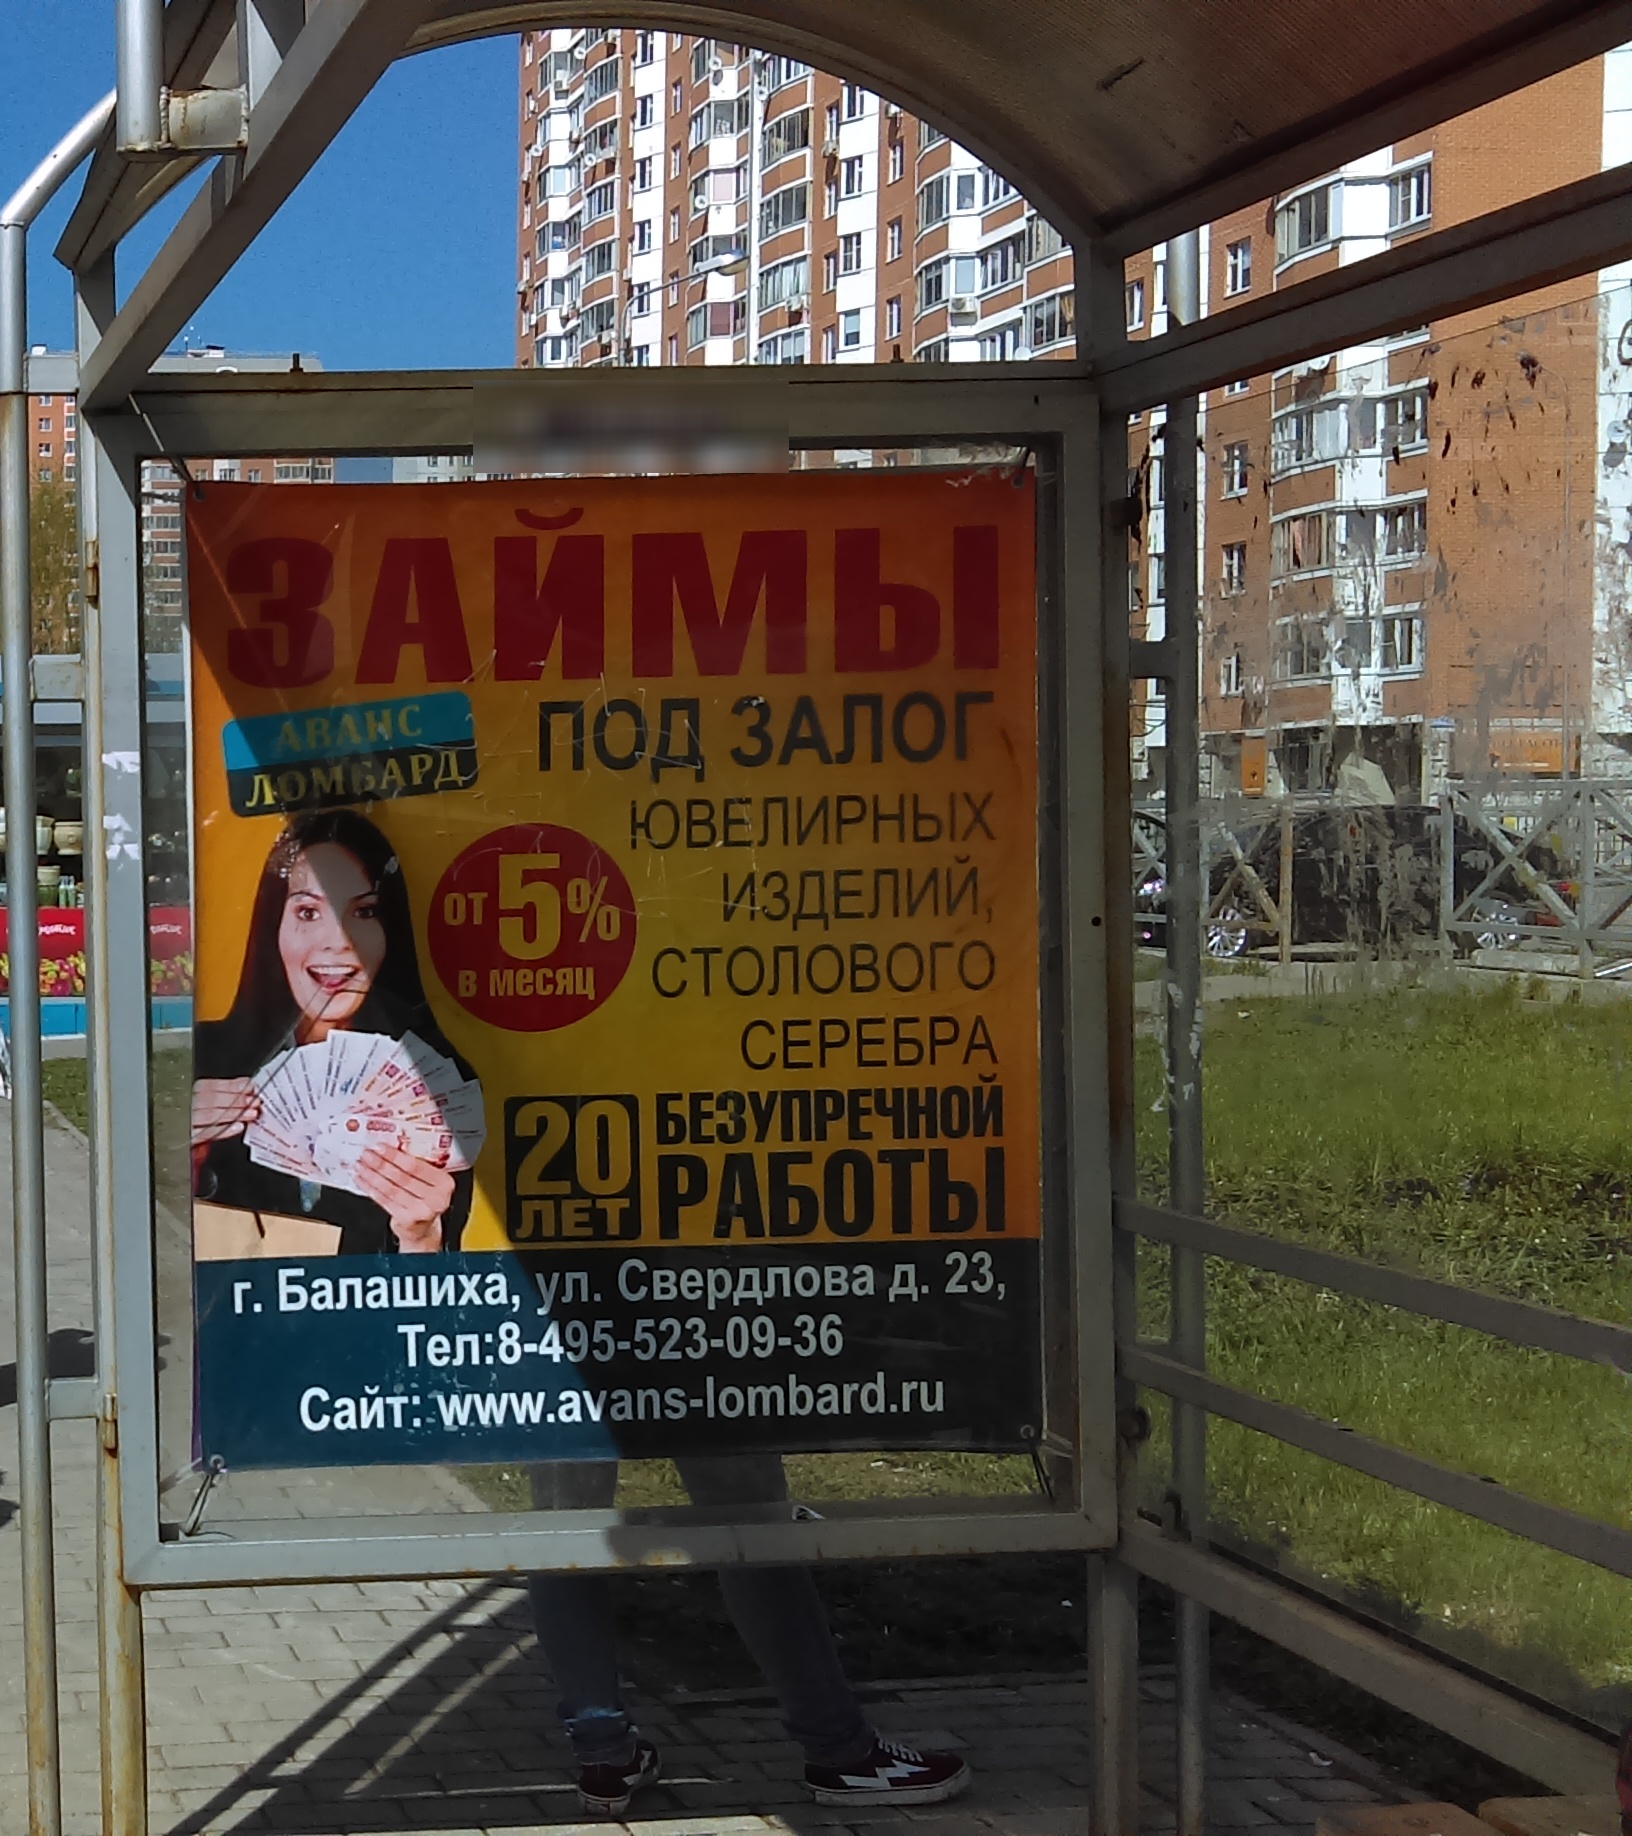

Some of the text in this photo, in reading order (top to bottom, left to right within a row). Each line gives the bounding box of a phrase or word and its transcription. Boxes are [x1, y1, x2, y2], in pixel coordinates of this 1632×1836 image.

[226, 507, 1000, 689] ЗАЙМЫ
[276, 704, 423, 754] АВАНС
[538, 690, 995, 783] ПОД ЗАЛОГ
[245, 749, 467, 808] ЛОМБАРД
[630, 792, 997, 850] ЮВЕЛИРНЫХ
[498, 852, 621, 960] 5%
[722, 855, 994, 931] ИЗДЕЛИЙ,
[489, 966, 596, 1000] месяц
[652, 939, 996, 998] СТОЛОВОГО
[741, 1014, 999, 1070] СЕРЕБРА
[655, 1071, 1004, 1145] БЕЗУПРЕЧНОЙ
[514, 1098, 632, 1196] 20
[515, 1199, 630, 1237] ЛЕТ
[656, 1145, 1006, 1239] РАБОТЫ
[232, 1251, 1006, 1315] г. Балашиха, ул. Свердлова д. 23,
[397, 1313, 844, 1368] Тел:8-495-523-09-36
[300, 1371, 945, 1432] Сайт: www.avans-lombard.ru
